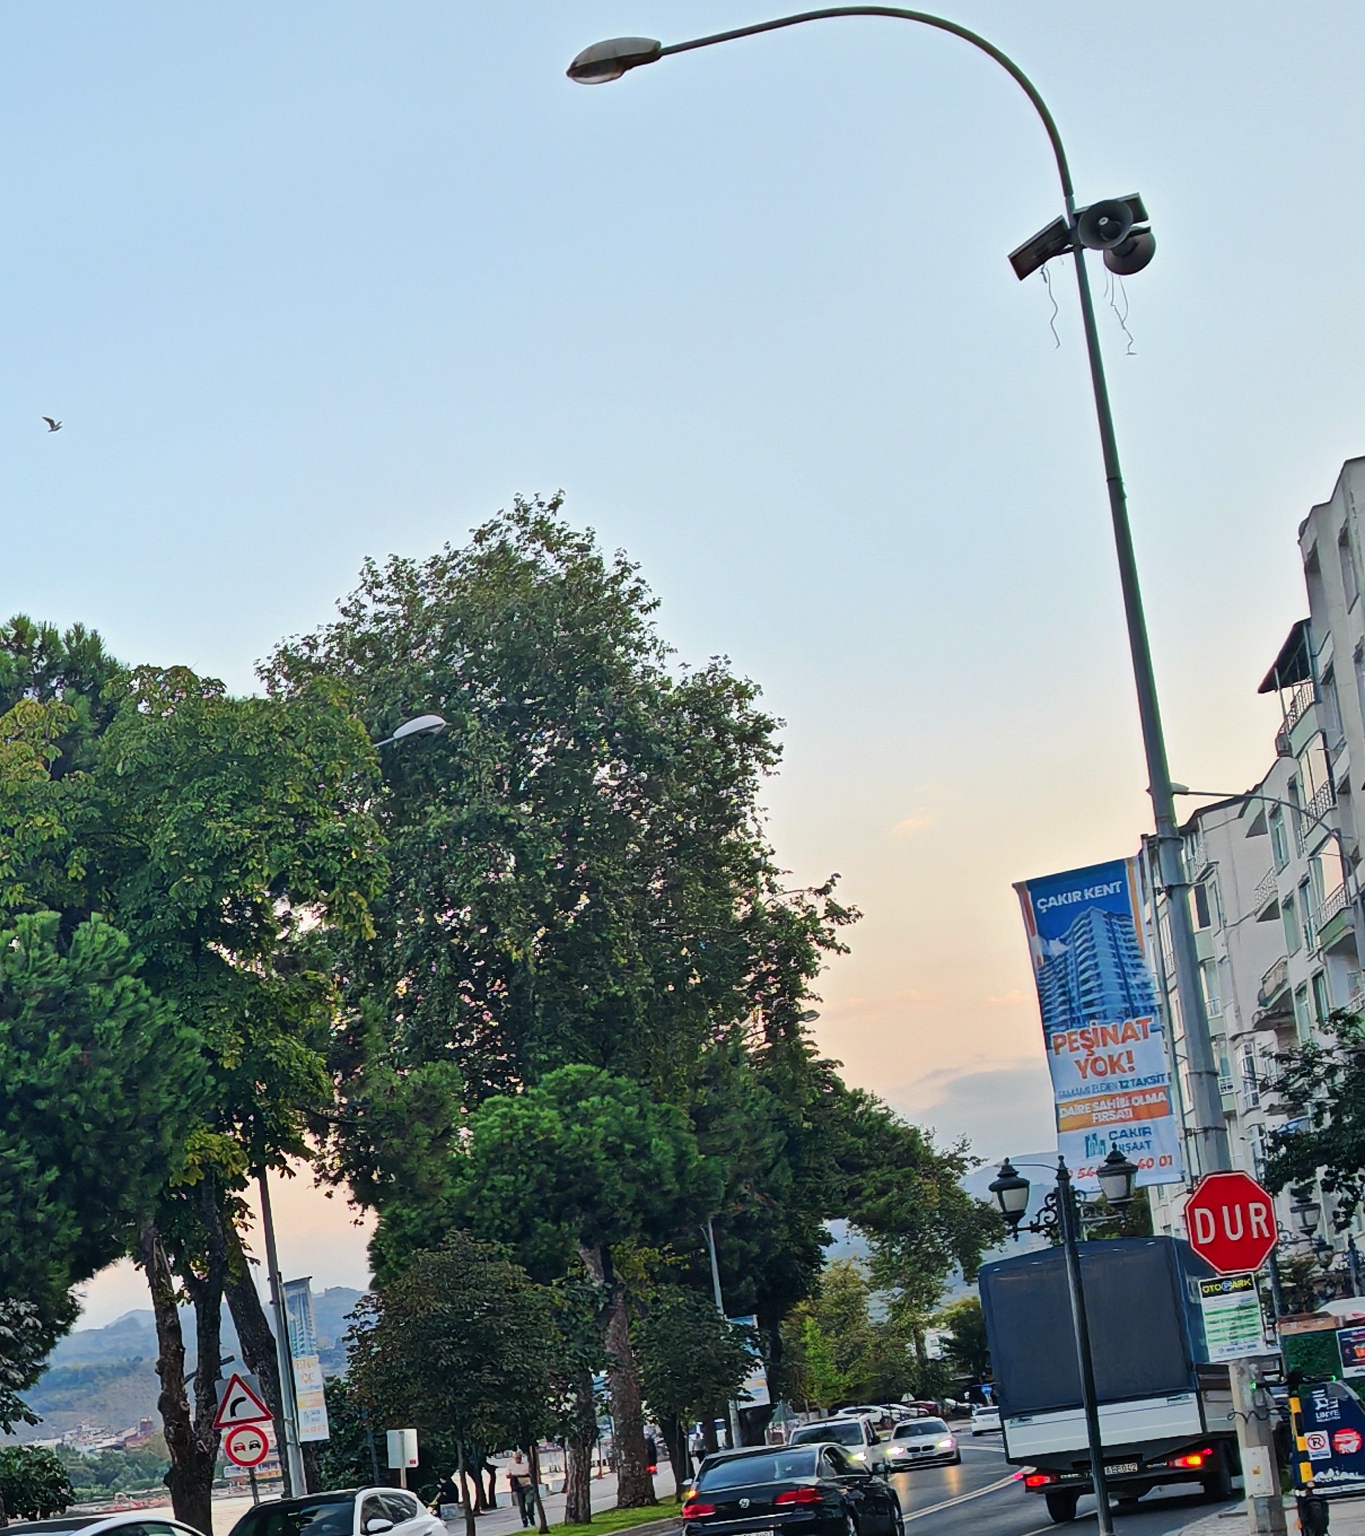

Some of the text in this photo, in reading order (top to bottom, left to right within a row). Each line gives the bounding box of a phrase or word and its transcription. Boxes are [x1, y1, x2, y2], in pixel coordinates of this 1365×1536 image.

[1036, 881, 1123, 914] ÇAKIR KENT
[1052, 1017, 1152, 1057] PEŞİNAT
[1074, 1049, 1136, 1079] YOK!
[1130, 1072, 1166, 1087] TAKSİT
[1059, 1091, 1167, 1118] DAİRE SAHİBİ OLMA
[1159, 1155, 1173, 1167] 01
[1194, 1202, 1270, 1244] DUR
